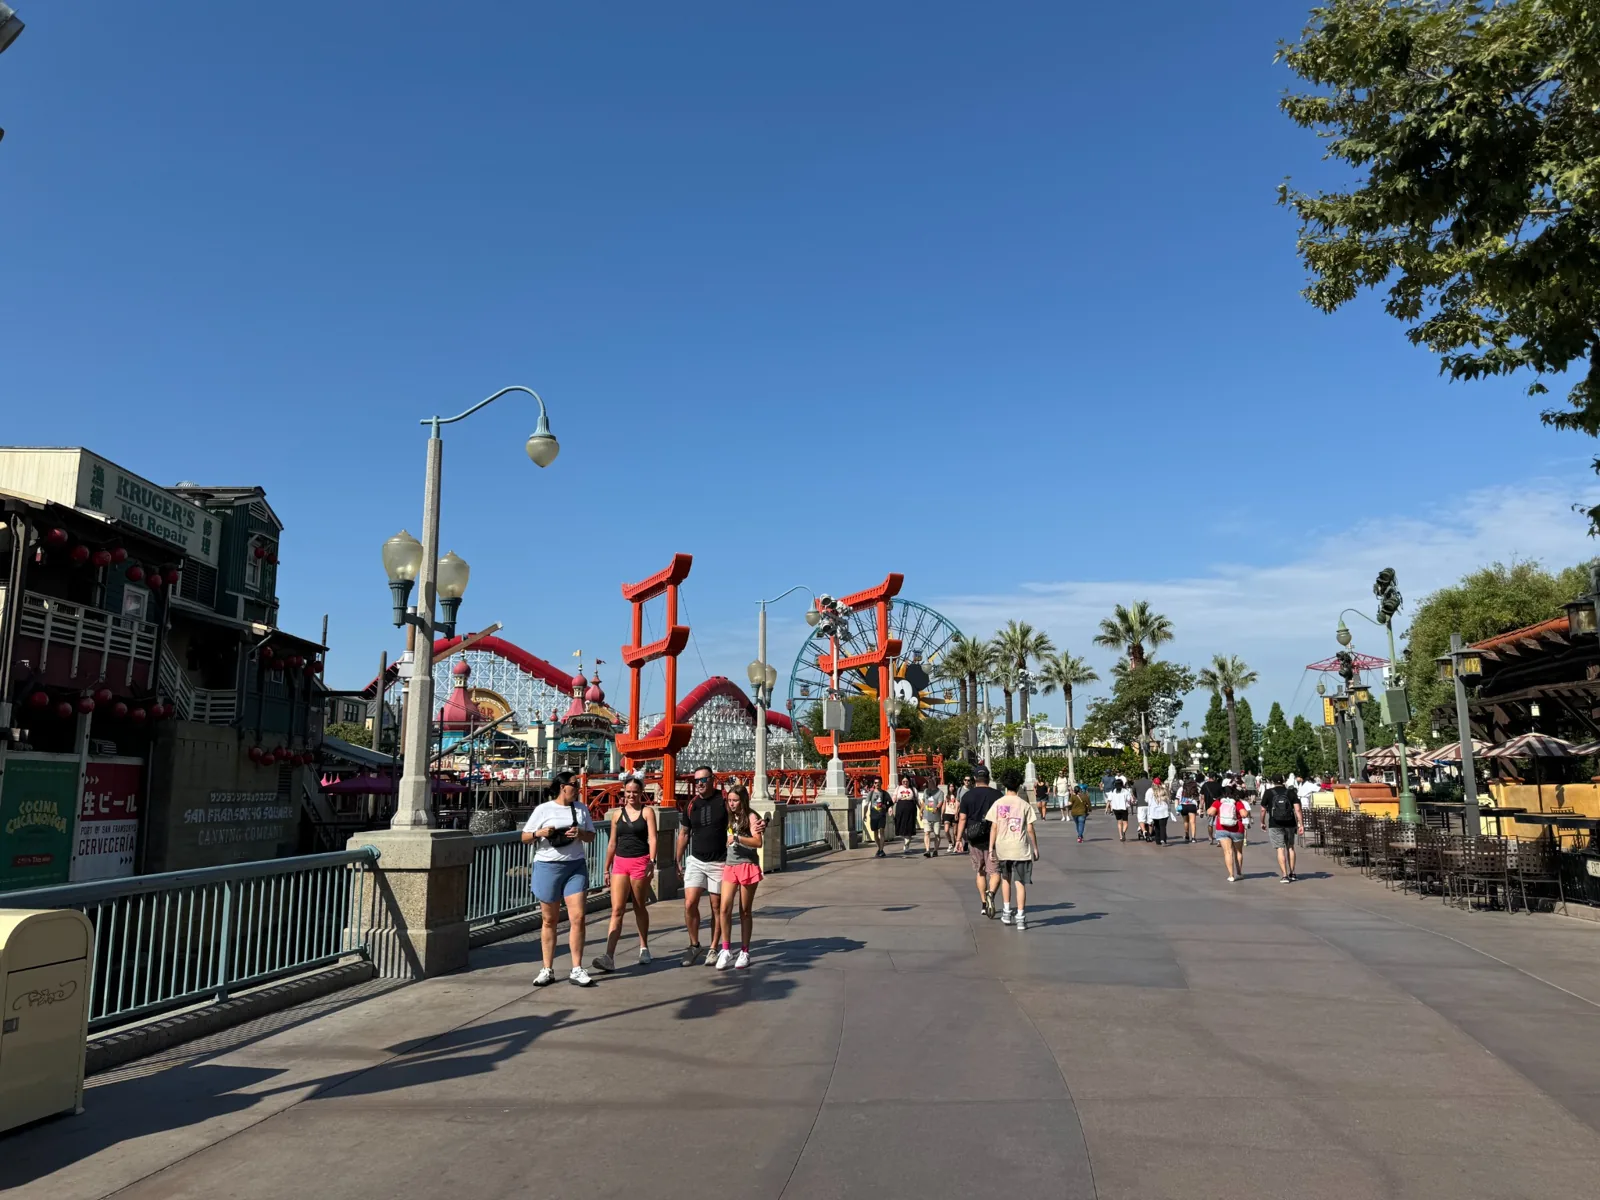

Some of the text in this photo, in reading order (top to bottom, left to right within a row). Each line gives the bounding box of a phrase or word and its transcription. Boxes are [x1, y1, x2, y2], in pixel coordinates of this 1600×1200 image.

[116, 475, 196, 529] KRUGER'S
[121, 504, 189, 546] Net Repair
[18, 799, 59, 815] COCINA
[83, 790, 138, 816] 生ビール
[183, 805, 293, 824] SAN FRANSOKYO SQUARE
[5, 811, 68, 835] CUCAMONGA
[80, 825, 93, 835] PORT
[102, 824, 111, 833] SAN
[78, 833, 134, 856] CERVECERÍA
[198, 825, 284, 846] CANNING COMPANY
